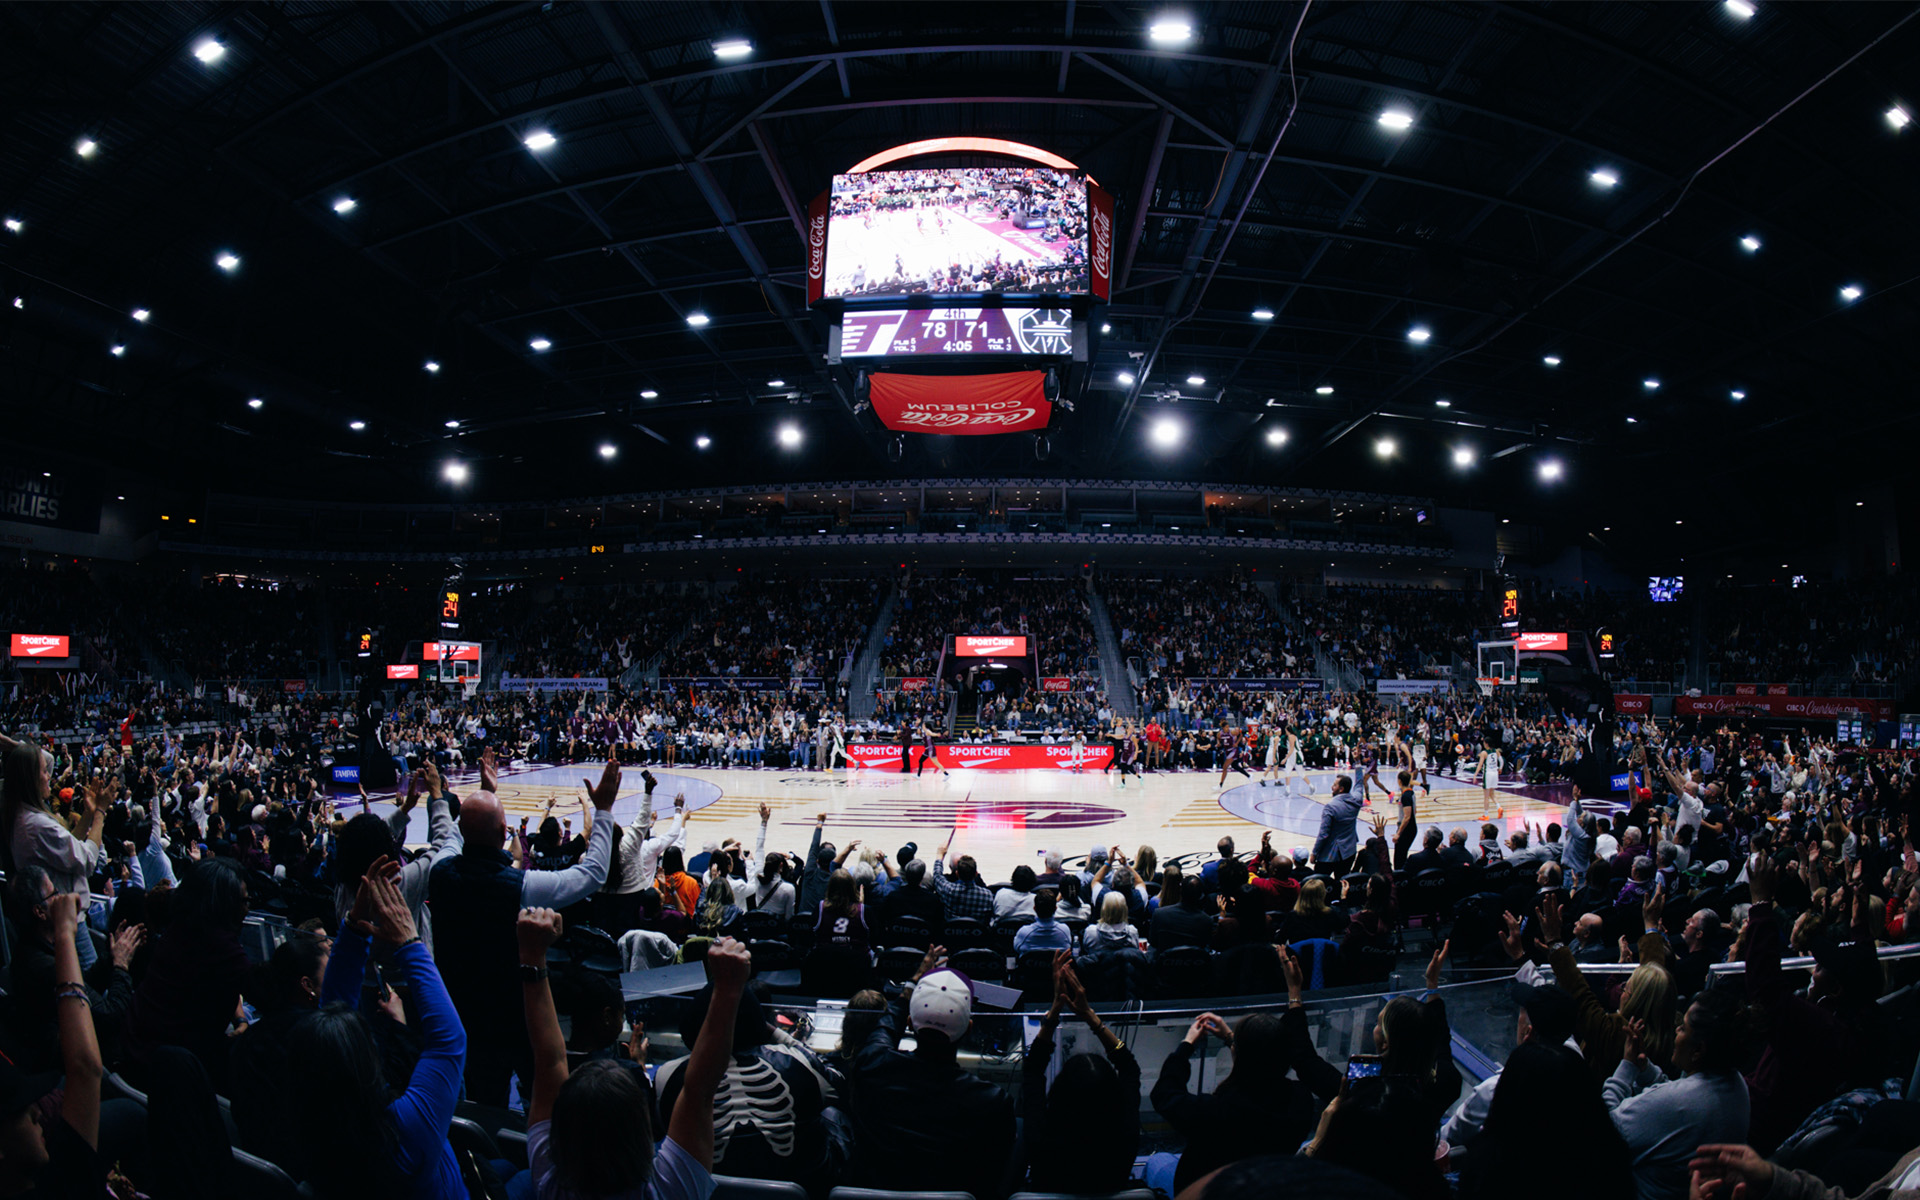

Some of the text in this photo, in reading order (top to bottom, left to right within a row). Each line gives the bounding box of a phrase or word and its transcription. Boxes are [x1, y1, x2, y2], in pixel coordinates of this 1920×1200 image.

[1092, 203, 1110, 279] Coca-Cola
[808, 215, 825, 279] Coca-Cola
[944, 309, 966, 319] 4th
[921, 321, 987, 338] 78 71
[943, 341, 972, 352] 4:05
[908, 400, 1021, 411] COLISEUM
[897, 408, 1036, 427] Coca-Cola
[444, 600, 458, 617] 24
[1504, 600, 1517, 616] 24
[20, 635, 60, 645] SPORTCHEK
[967, 638, 1015, 647] SPORTCHEK
[1044, 680, 1069, 690] Coca-Cola
[853, 745, 1108, 757] SPORTCHK SPORTCHEK SPOCHEK
[334, 769, 358, 778] TAMPAX
[1612, 776, 1640, 787] TAMX
